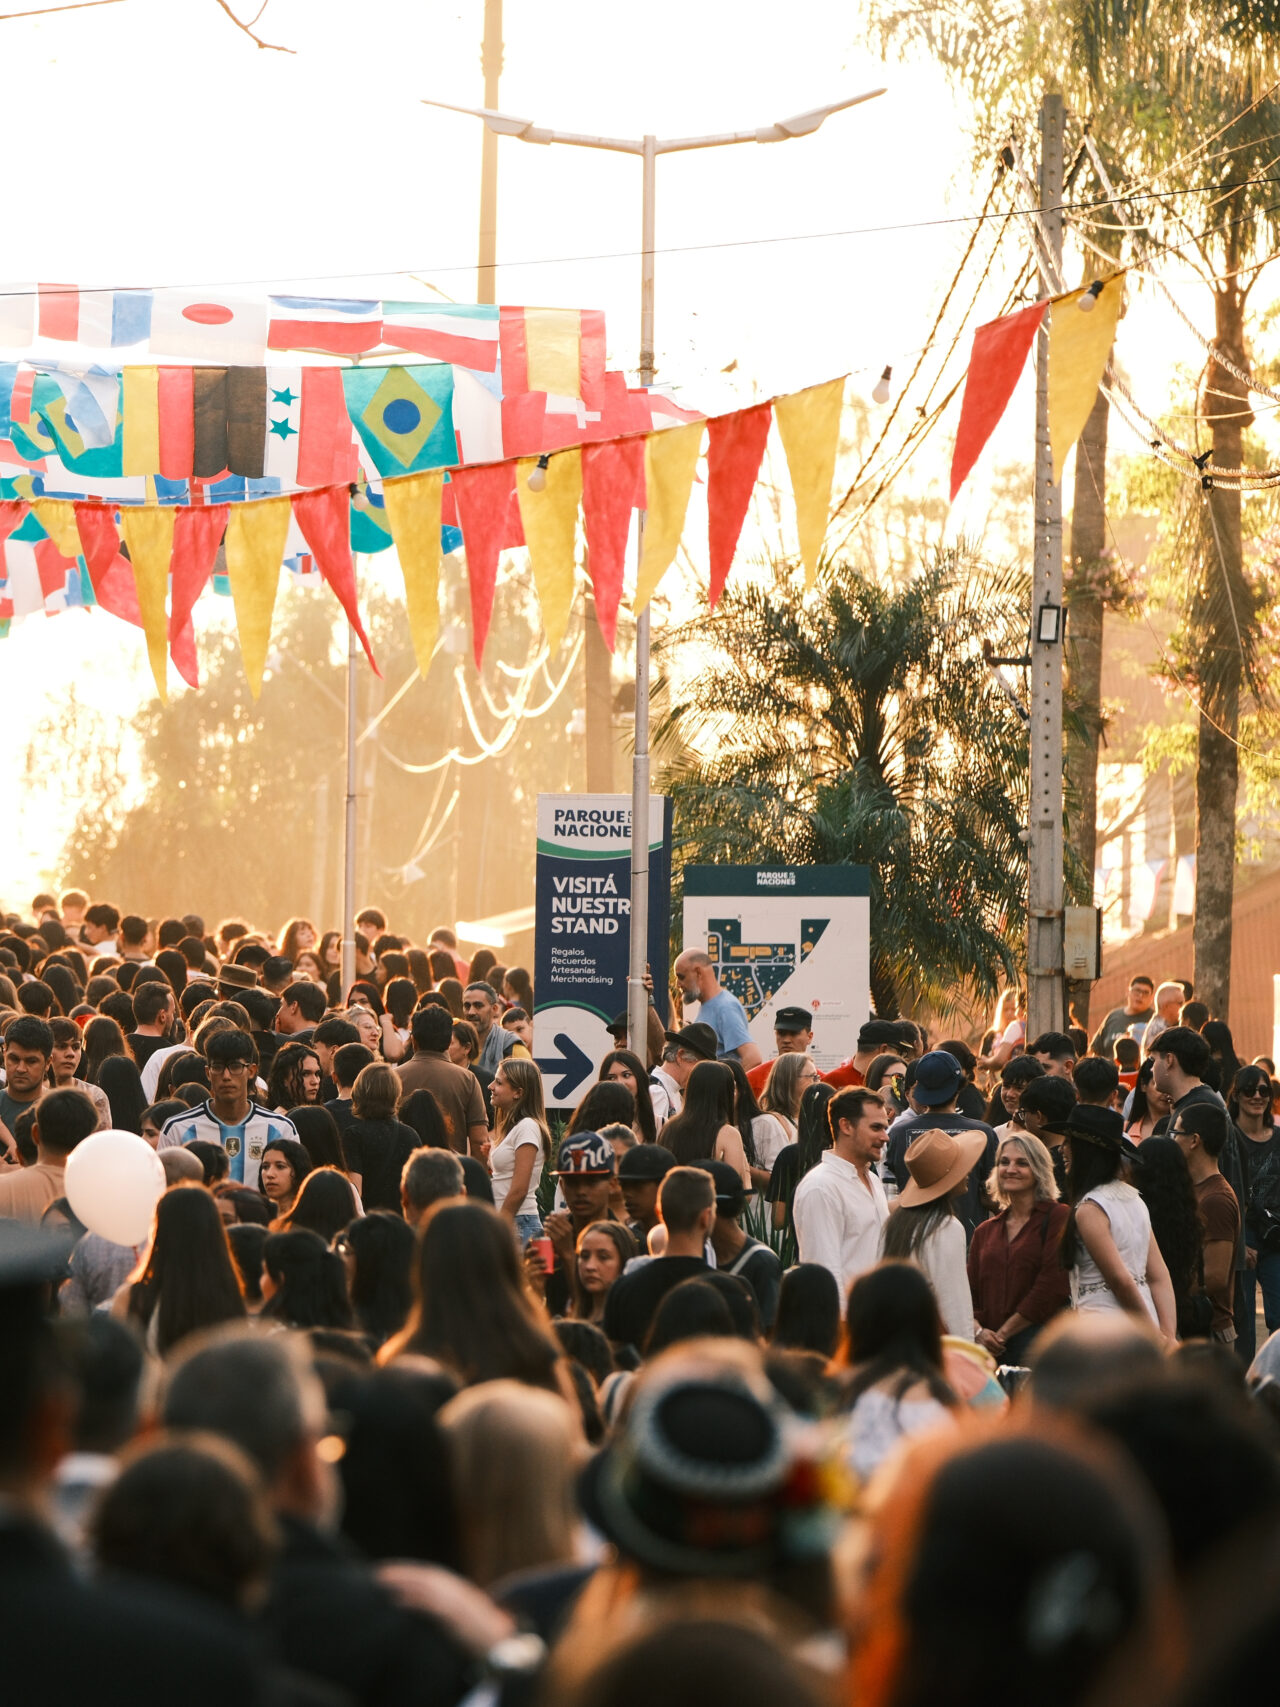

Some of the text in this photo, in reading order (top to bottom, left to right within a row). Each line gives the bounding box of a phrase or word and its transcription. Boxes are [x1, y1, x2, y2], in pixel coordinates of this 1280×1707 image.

[554, 809, 625, 824] PARQUE
[554, 824, 632, 838] NACIONE
[757, 871, 788, 880] PARQUE
[552, 873, 618, 894] VISITÁ
[756, 878, 796, 886] NACIONES
[552, 897, 631, 915] NUESTR
[551, 917, 619, 935] STAND
[551, 947, 585, 957] Regalos
[551, 957, 596, 965] Recuerdos
[551, 965, 596, 974] Artesanías
[550, 974, 613, 986] Merchandising
